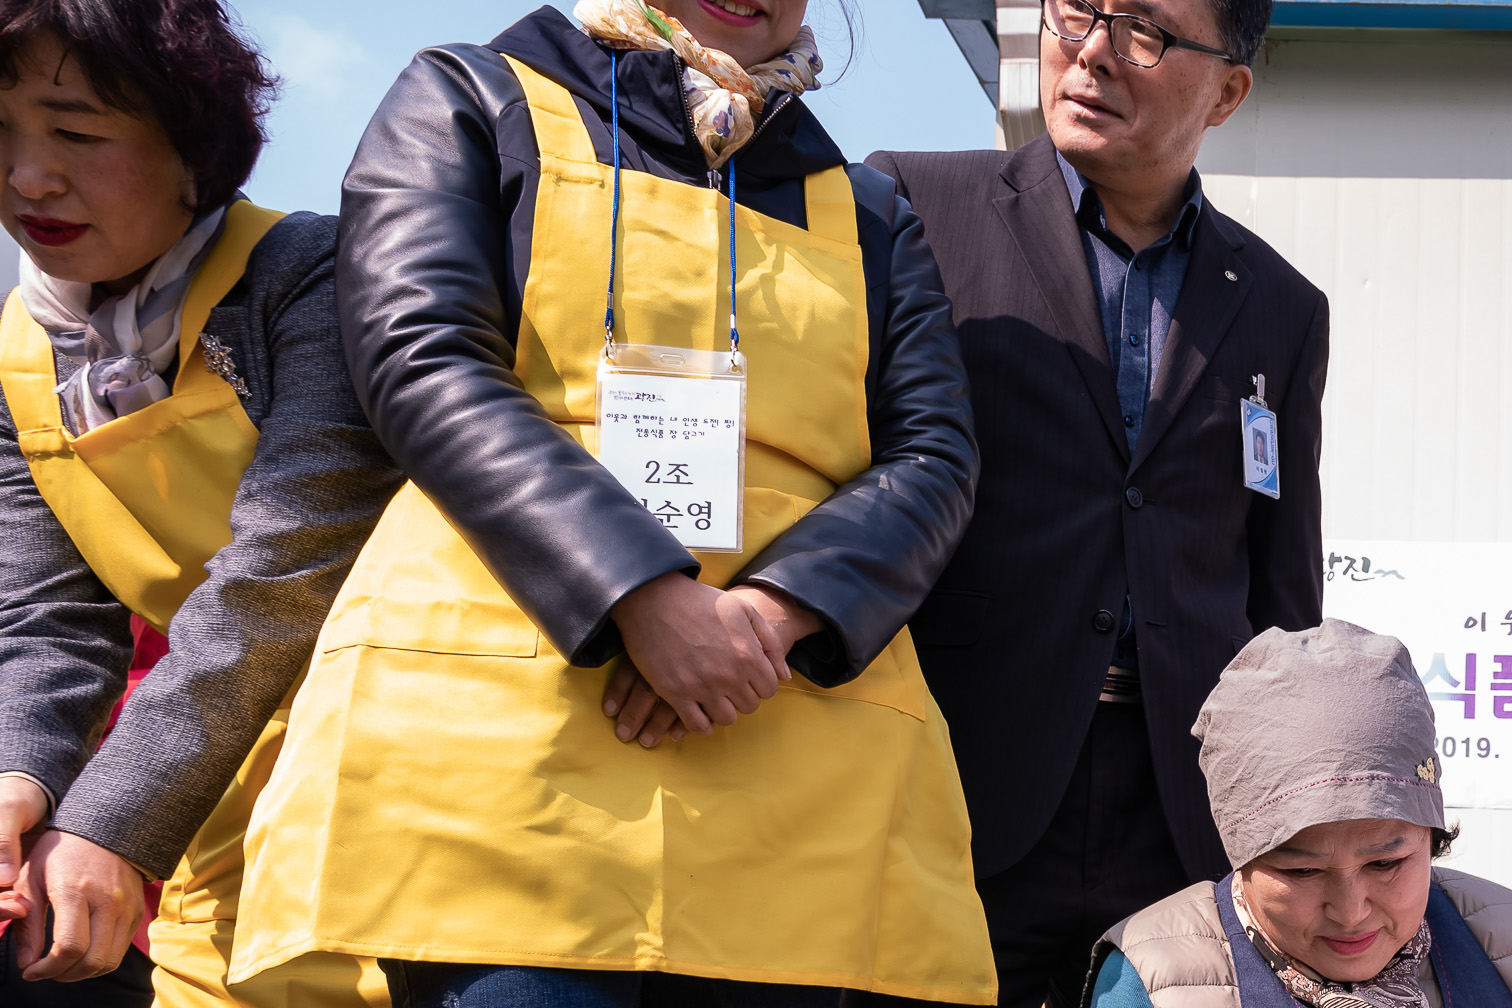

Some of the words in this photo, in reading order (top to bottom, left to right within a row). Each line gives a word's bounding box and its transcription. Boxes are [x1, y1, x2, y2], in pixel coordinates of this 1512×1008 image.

[644, 460, 694, 485] 2조
[641, 498, 712, 531] 순영
[1434, 736, 1500, 759] 019.
